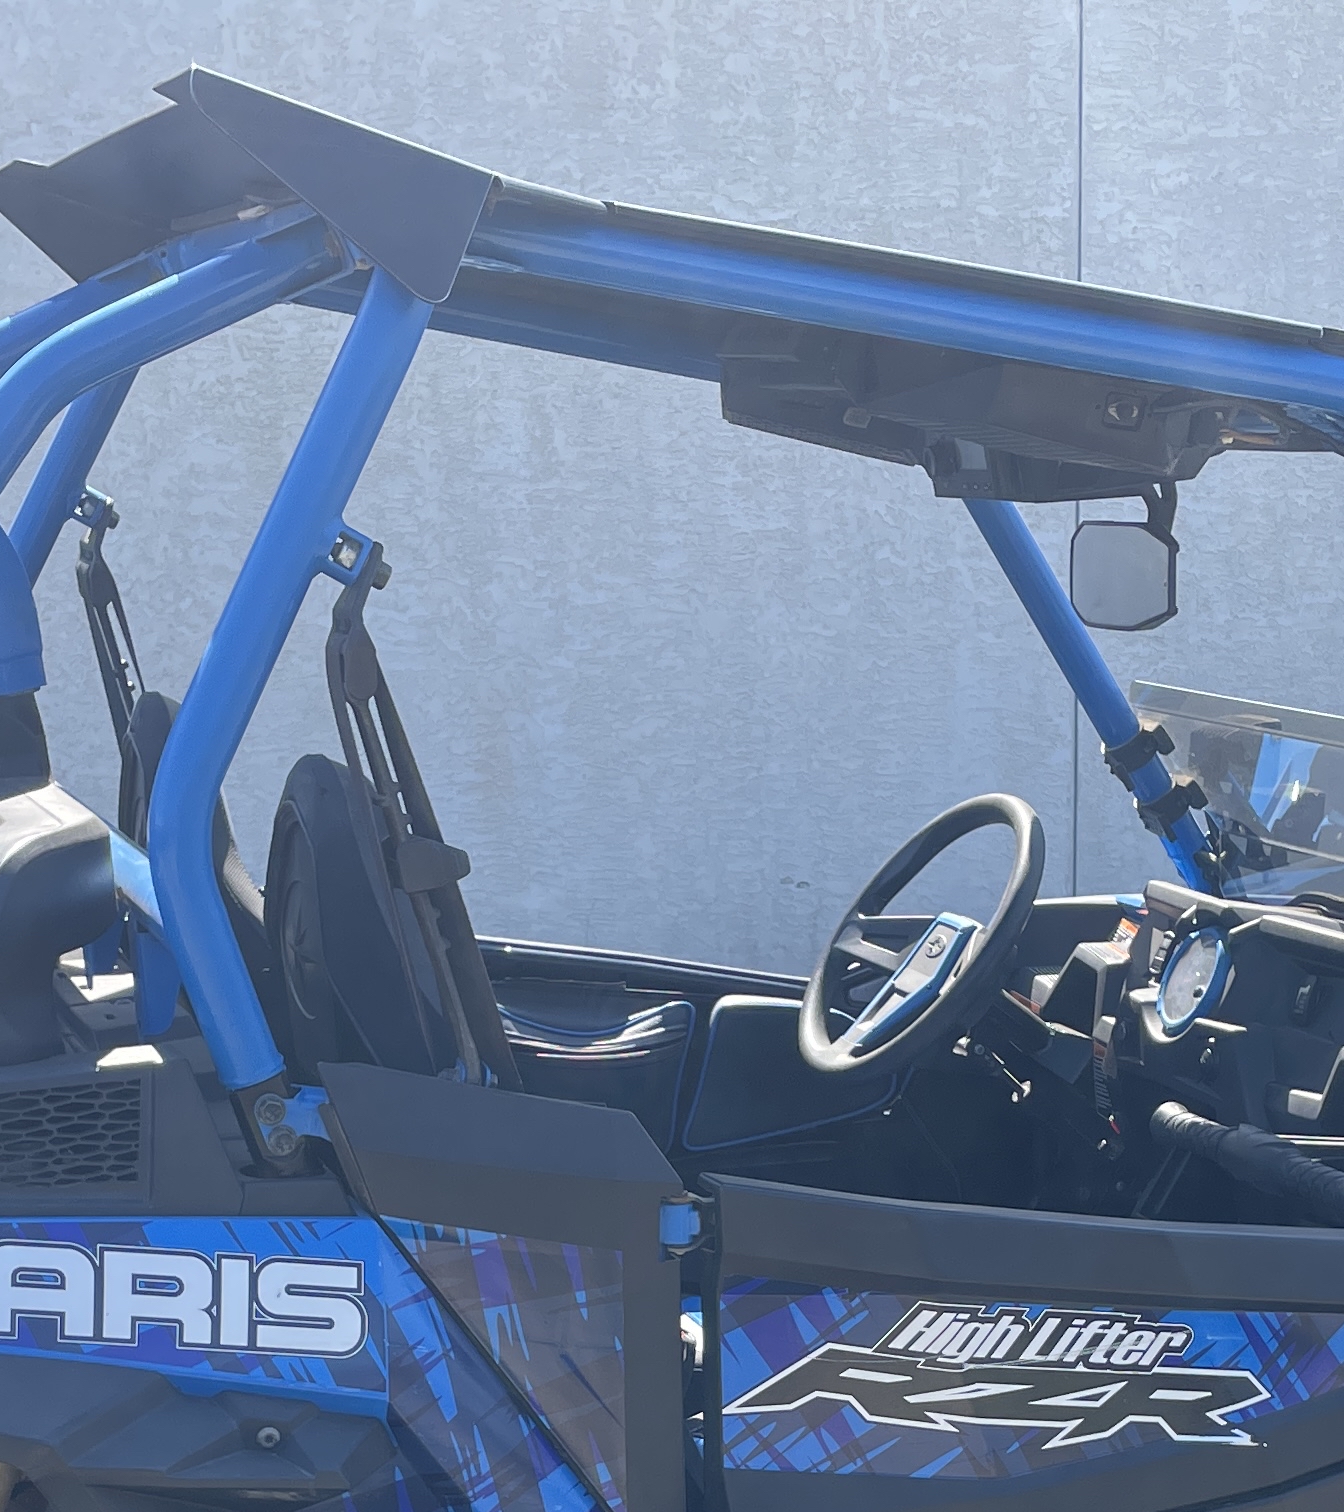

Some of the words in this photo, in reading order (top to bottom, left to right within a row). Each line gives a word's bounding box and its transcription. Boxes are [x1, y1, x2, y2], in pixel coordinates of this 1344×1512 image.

[891, 1308, 1031, 1361] High
[1022, 1316, 1190, 1368] Lifter
[722, 1343, 1270, 1449] RZR
